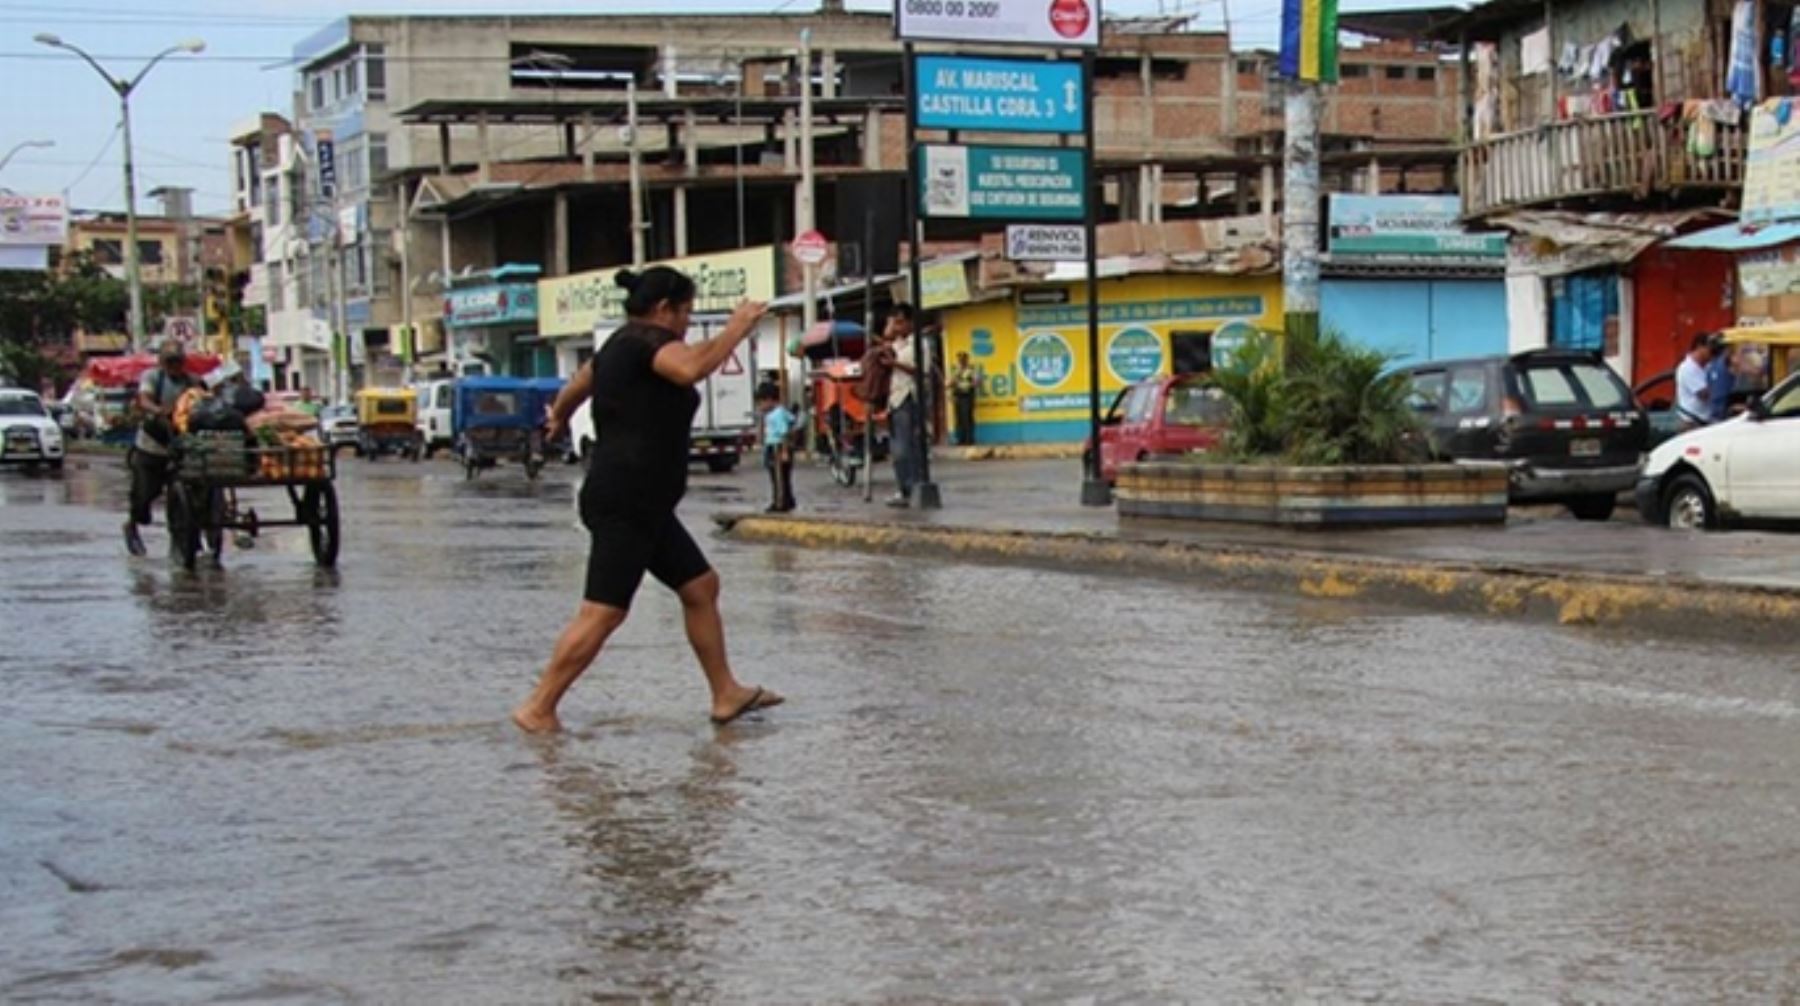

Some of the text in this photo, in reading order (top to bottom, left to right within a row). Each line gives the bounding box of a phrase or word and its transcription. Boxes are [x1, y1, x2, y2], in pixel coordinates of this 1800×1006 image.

[946, 1, 964, 16] 00
[934, 68, 1040, 92] AV. MARISCAL
[920, 94, 993, 115] CASTILLA
